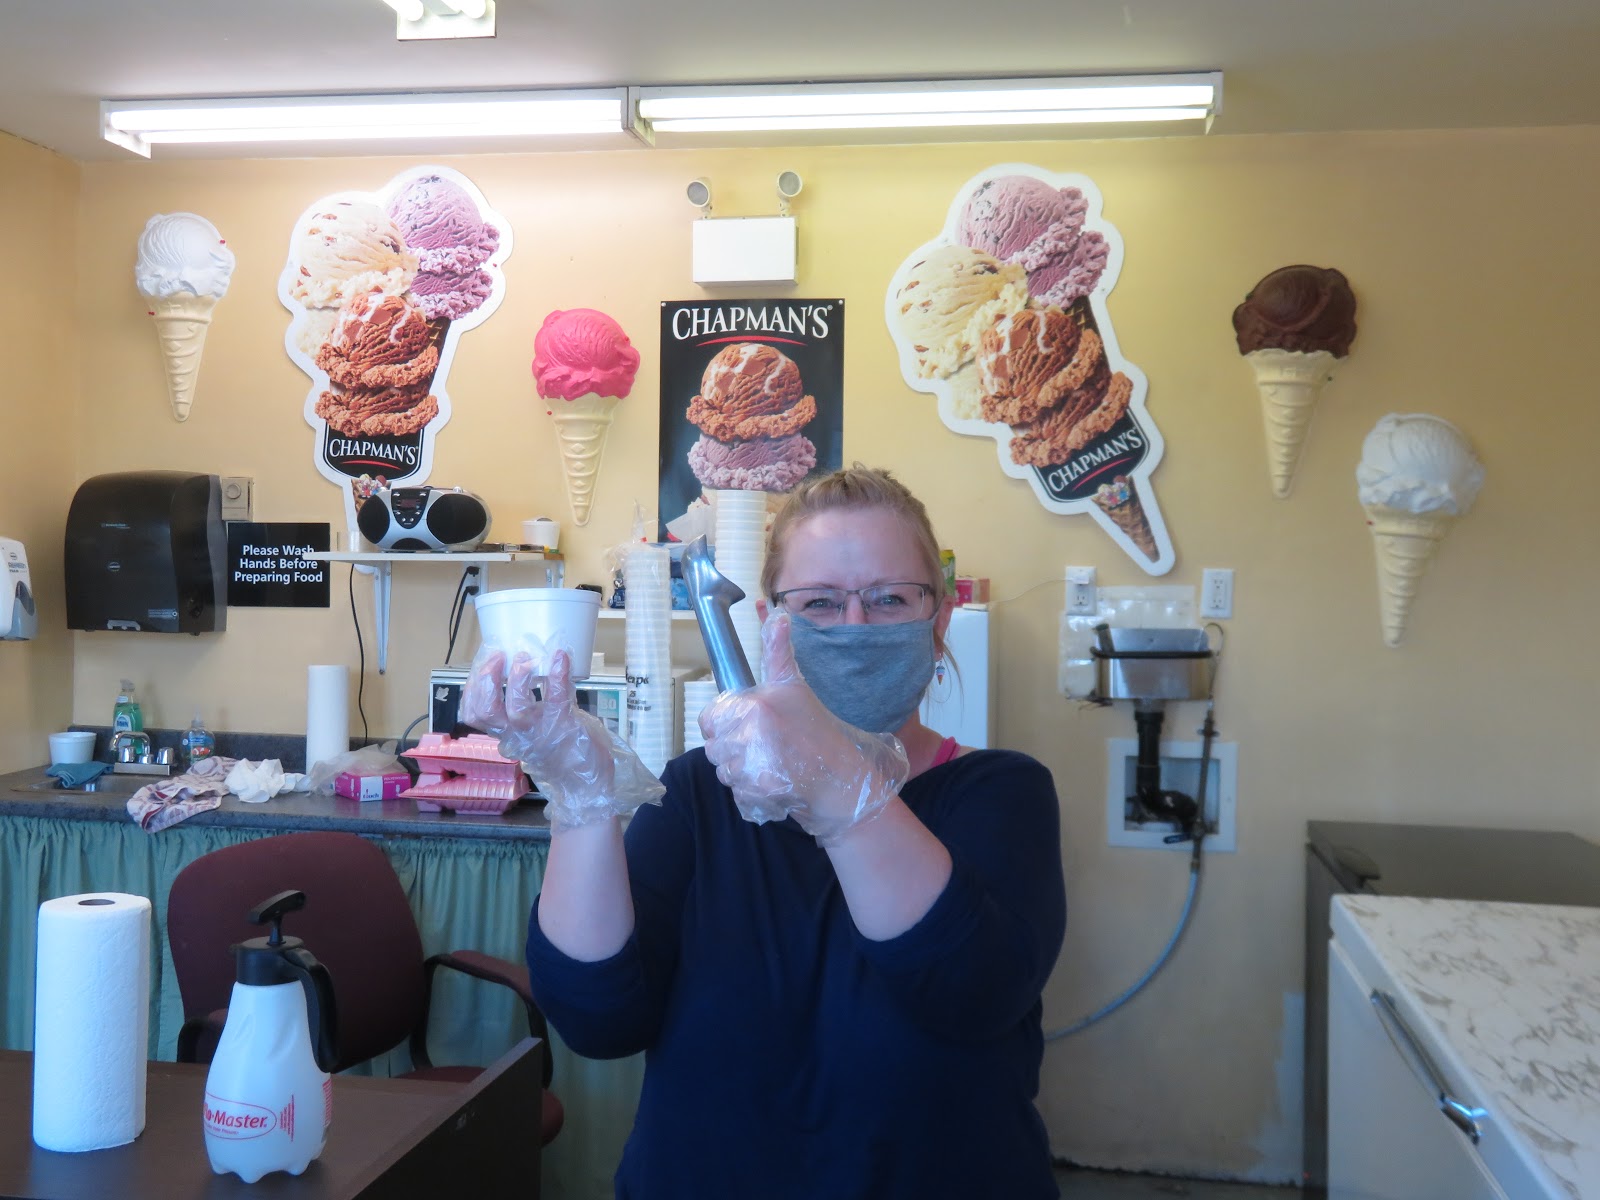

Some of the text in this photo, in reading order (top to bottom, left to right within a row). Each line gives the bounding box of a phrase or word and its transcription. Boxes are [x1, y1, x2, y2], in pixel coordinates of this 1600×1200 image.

[672, 304, 830, 340] CHAPMAN'S
[329, 438, 417, 465] CHAPMAN'S
[1047, 428, 1142, 492] CHAPMAN'S
[242, 544, 315, 556] Please Wash
[239, 557, 318, 569] Hands Before
[234, 571, 323, 585] Preparing Food
